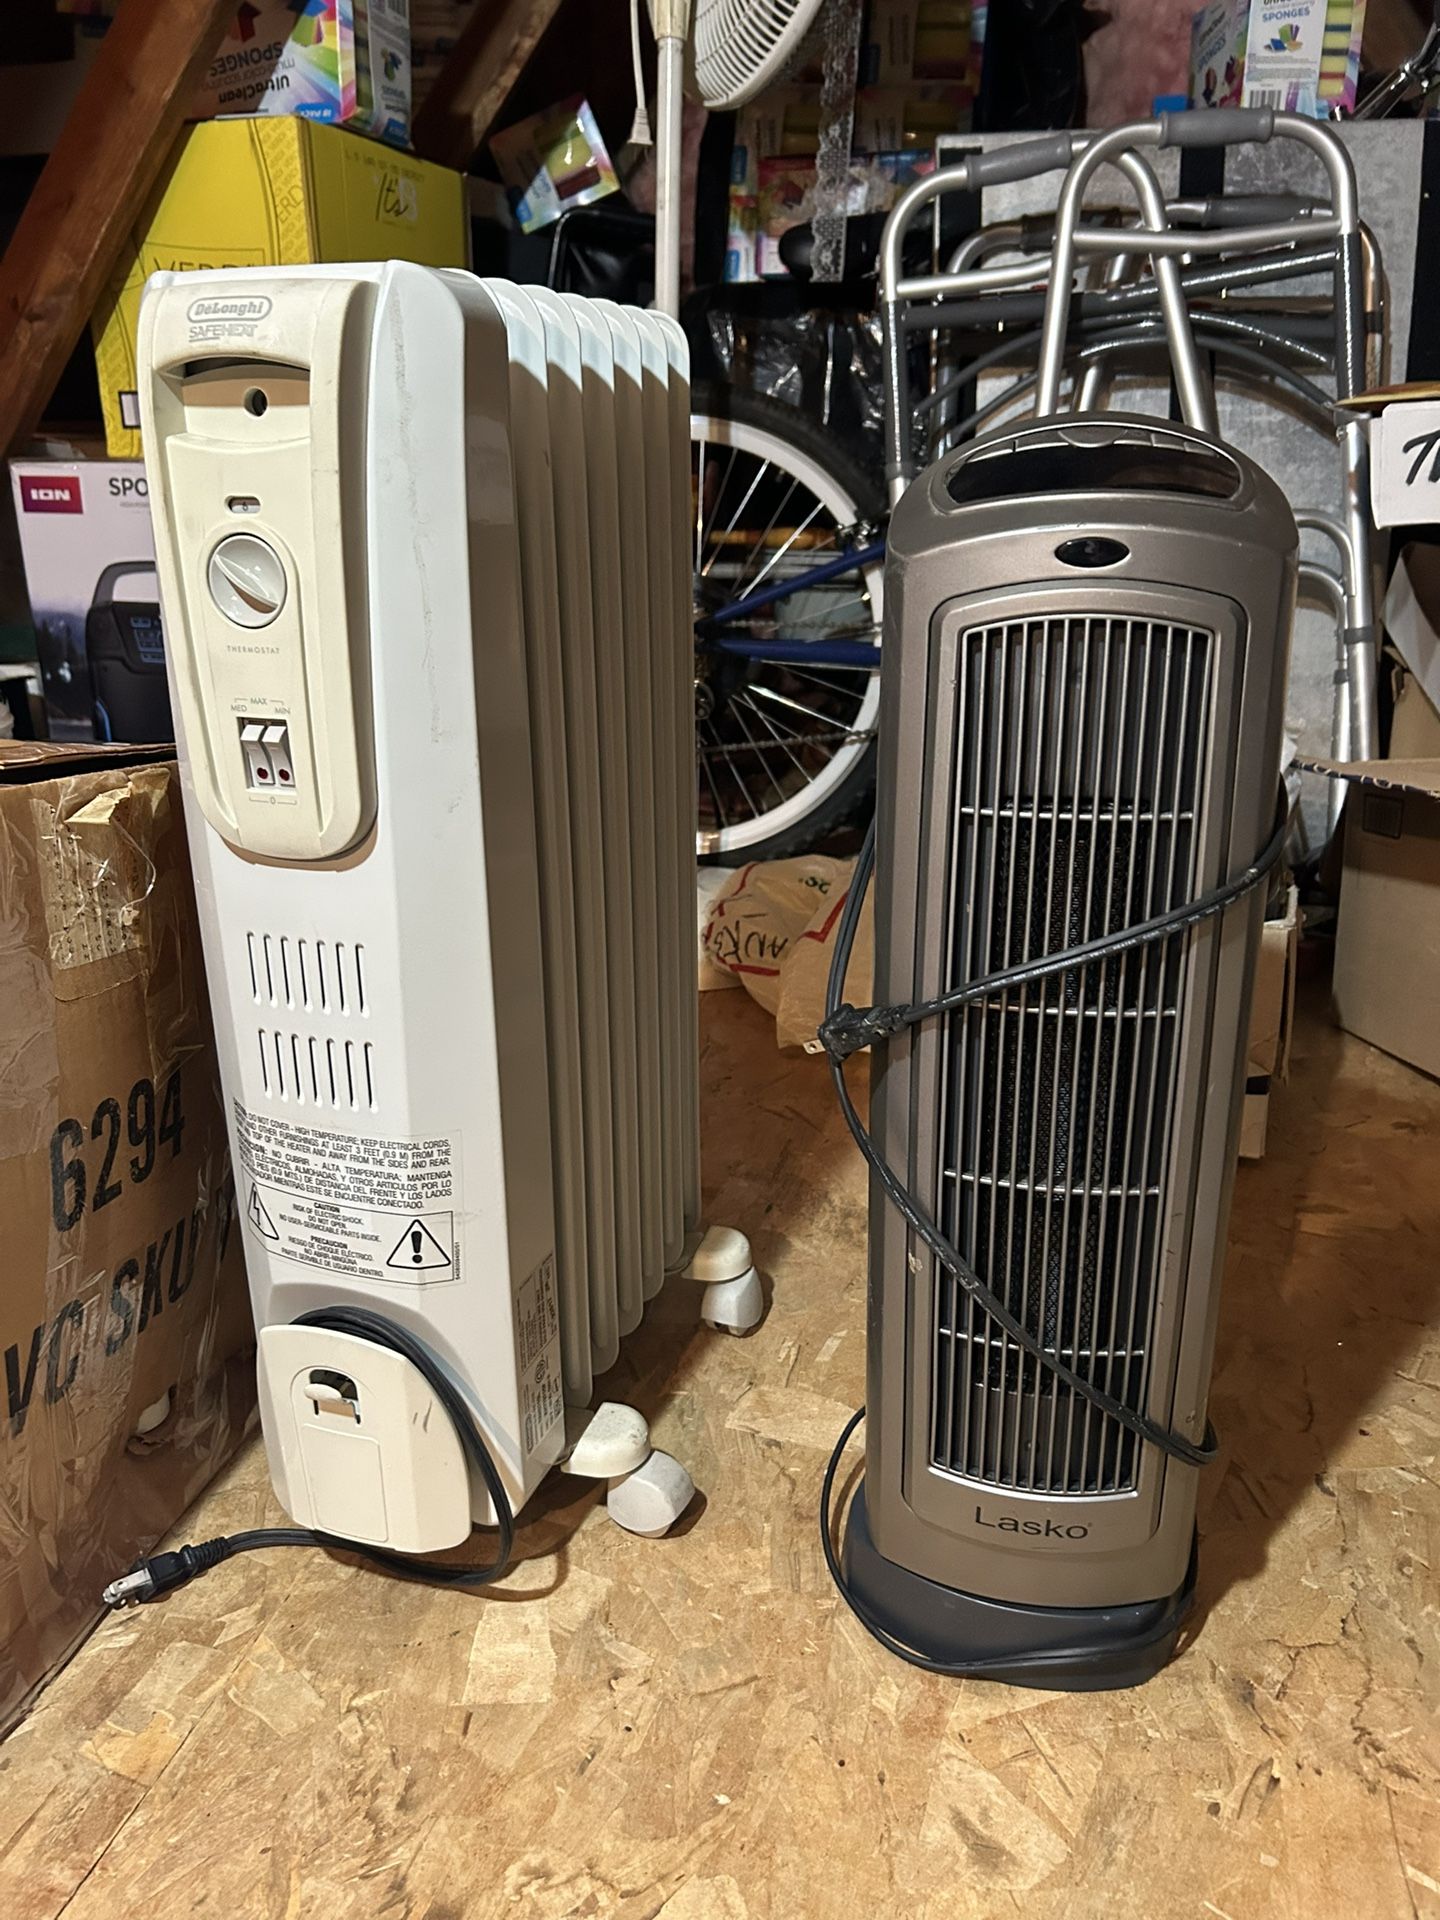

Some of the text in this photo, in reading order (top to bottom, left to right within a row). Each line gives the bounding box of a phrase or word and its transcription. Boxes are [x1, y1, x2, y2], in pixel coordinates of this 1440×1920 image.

[1262, 7, 1311, 23] SPONGES
[219, 75, 290, 104] UltraClean
[194, 301, 264, 317] DeLonghi
[188, 324, 258, 339] SAFEHEAT
[30, 488, 71, 501] ION
[227, 645, 280, 655] THERMOSTAT
[231, 704, 248, 712] MED
[258, 1124, 278, 1137] OTHER
[321, 1141, 330, 1149] AT
[332, 1142, 353, 1153] LEAST
[356, 1146, 361, 1154] 3
[363, 1147, 380, 1157] FEET
[411, 1150, 434, 1160] FROM
[437, 1147, 451, 1157] THE
[270, 1119, 290, 1131] COVER
[294, 1126, 310, 1136] HIGH
[360, 1138, 378, 1148] KEEP
[379, 1140, 421, 1151] ELECTRICAL
[51, 1070, 186, 1233] 6294
[252, 1130, 263, 1140] TOP
[264, 1134, 272, 1143] OF
[273, 1137, 286, 1148] THE
[287, 1141, 312, 1154] HEATER
[313, 1147, 327, 1158] AND
[328, 1150, 348, 1161] AWAY
[349, 1153, 370, 1165] FROM
[371, 1157, 386, 1167] THE
[387, 1159, 409, 1169] SIDES
[411, 1160, 427, 1169] AND
[271, 1149, 282, 1159] NO
[322, 1162, 341, 1172] ALTA
[407, 1170, 452, 1182] MANTENGA
[304, 1175, 314, 1185] DE
[315, 1177, 352, 1193] DISTANCIA
[353, 1185, 368, 1195] DEL
[369, 1187, 398, 1199] FRENTE
[399, 1191, 406, 1199] Y
[407, 1191, 424, 1201] LOS
[425, 1187, 452, 1199] LADOS
[340, 1174, 347, 1182] Y
[349, 1175, 374, 1187] OTROS
[376, 1180, 418, 1192] ARTICULOS
[421, 1181, 438, 1191] POR
[441, 1179, 452, 1188] LO
[306, 1184, 323, 1196] ESTE
[323, 1188, 333, 1198] SE
[334, 1190, 376, 1205] ENCUENTRE
[292, 1203, 305, 1213] RISK
[306, 1206, 313, 1214] OF
[314, 1209, 341, 1222] ELECTRIC
[313, 1202, 341, 1213] CAUTION
[279, 1213, 287, 1222] NO
[341, 1229, 360, 1239] PARTS
[308, 1214, 317, 1222] DO
[318, 1217, 329, 1225] NOT
[304, 1247, 313, 1256] NO
[308, 1241, 316, 1250] DE
[316, 1244, 340, 1256] CHOQUE
[281, 1246, 298, 1259] PARTE
[324, 1259, 331, 1268] DE
[332, 1261, 358, 1274] USUARIO
[105, 1208, 202, 1356] SKU
[975, 1506, 1089, 1540] Lasko
